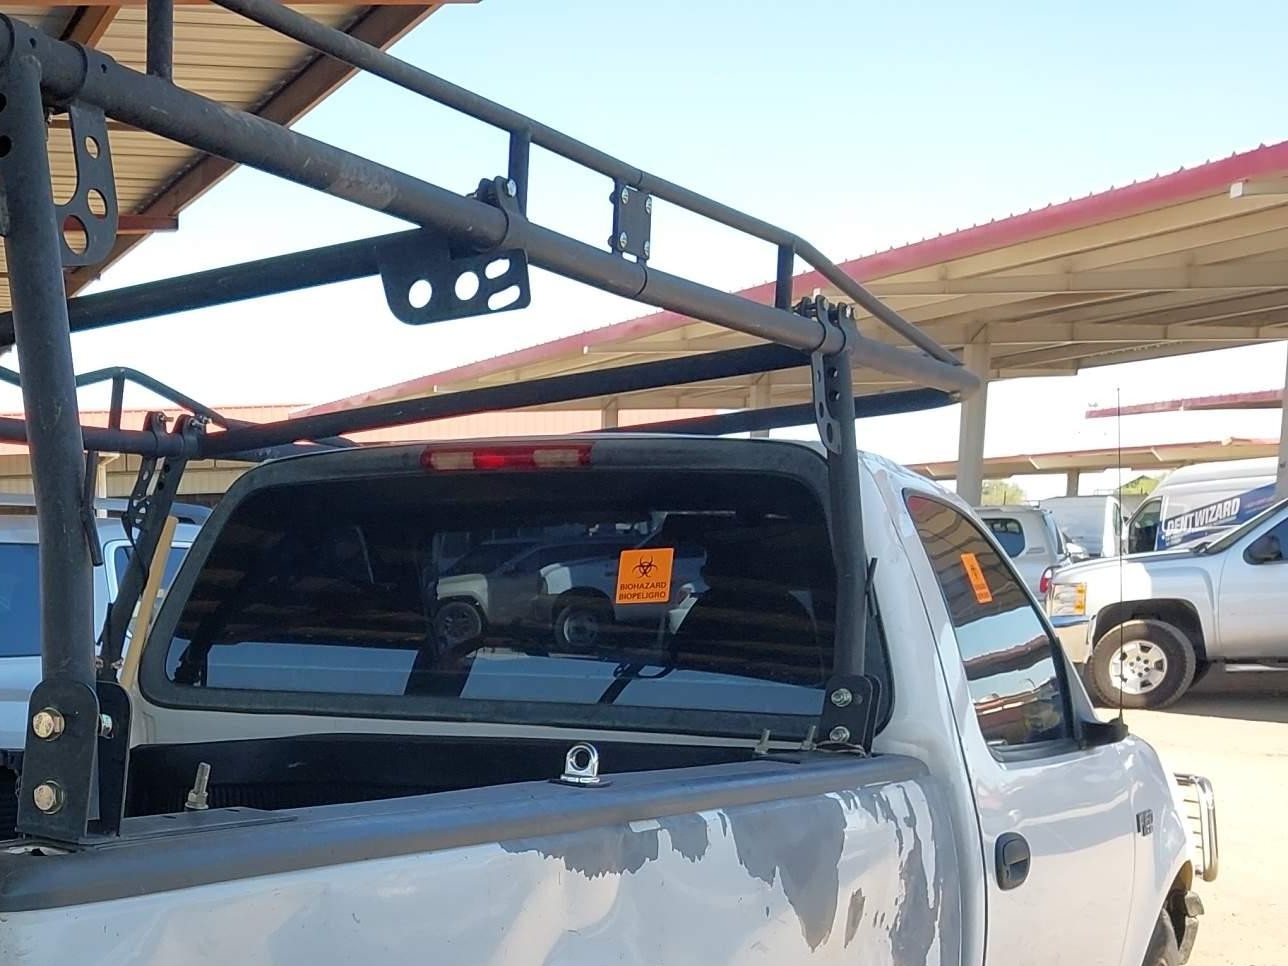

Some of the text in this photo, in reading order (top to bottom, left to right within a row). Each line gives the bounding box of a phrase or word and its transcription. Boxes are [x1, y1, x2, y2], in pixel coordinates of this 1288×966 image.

[1194, 497, 1241, 527] WIZARD
[620, 581, 667, 591] BIOHAZARD
[619, 591, 666, 600] BIOPELIGRO
